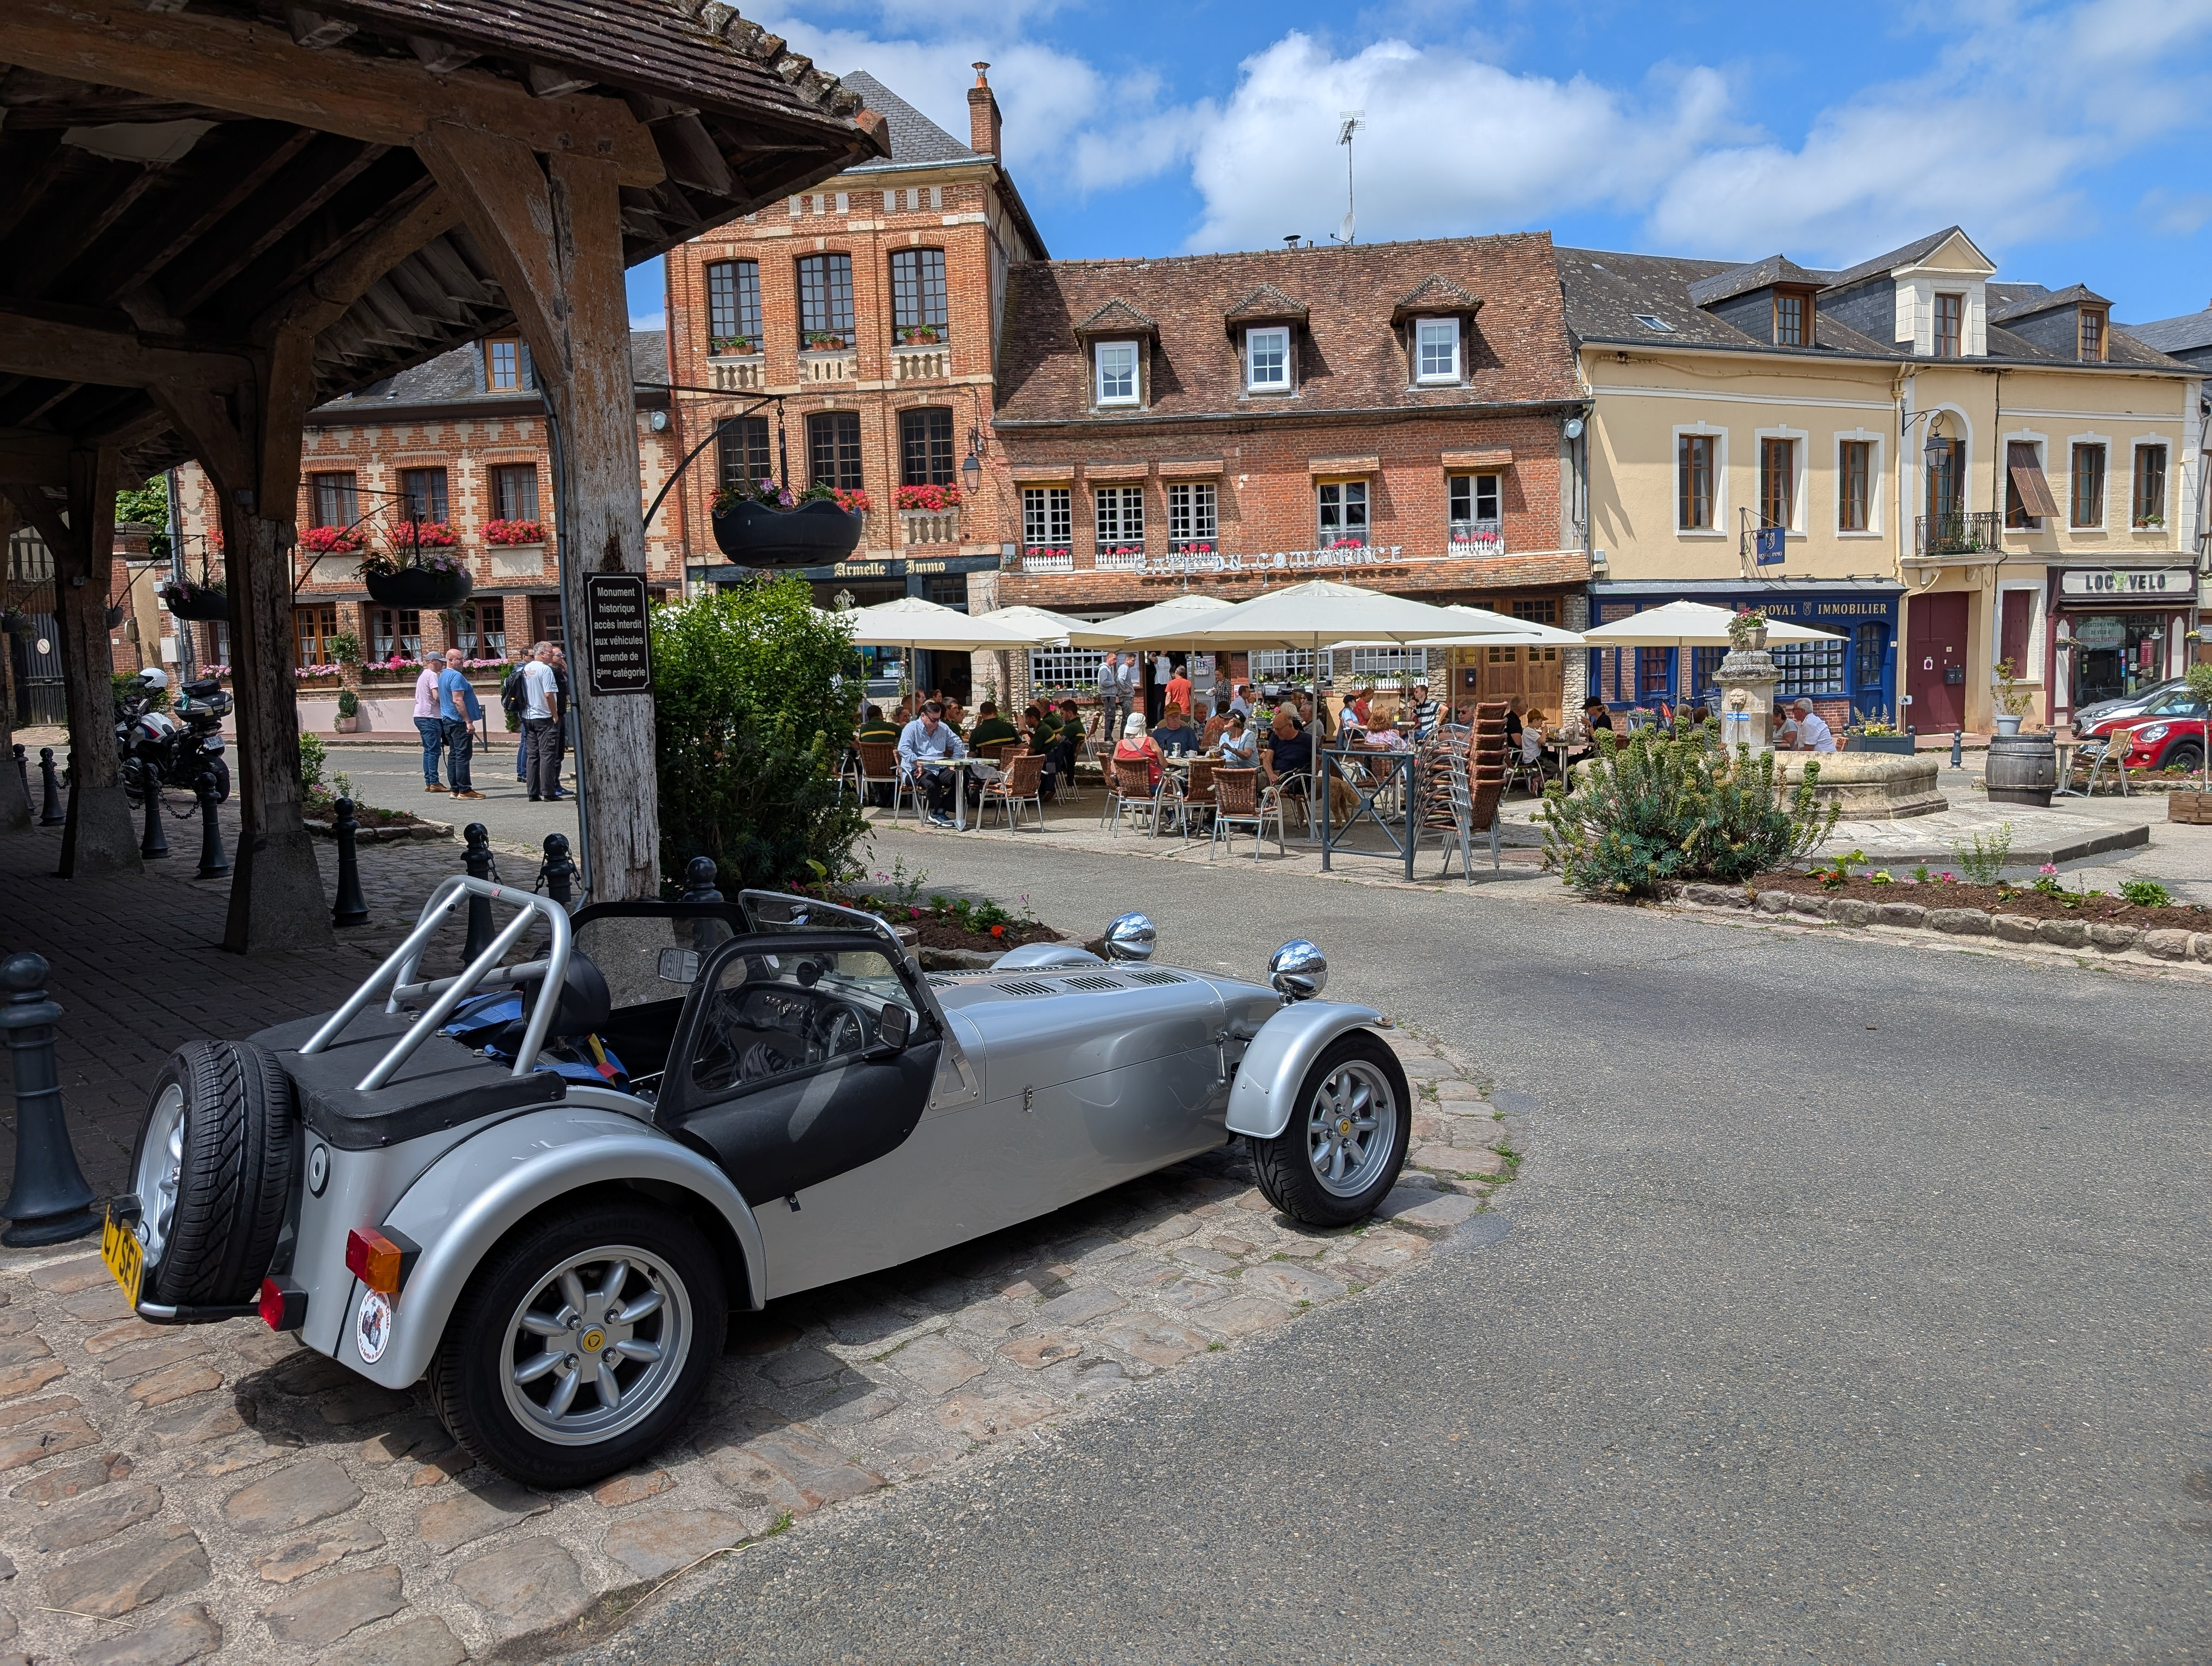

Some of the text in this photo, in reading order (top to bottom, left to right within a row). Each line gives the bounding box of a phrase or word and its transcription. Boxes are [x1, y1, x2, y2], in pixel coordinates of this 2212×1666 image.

[1211, 554, 1243, 572] DU
[1256, 546, 1403, 569] COMMERCE
[834, 560, 946, 577] Armelle Immo
[597, 587, 635, 597] Monument
[599, 604, 635, 614] historique
[1761, 603, 1887, 616] ROYAL IMMOBILIER
[594, 619, 642, 630] accès interdit
[609, 635, 644, 645] véhicules
[600, 651, 639, 662] amende de
[596, 668, 646, 679] 5ème catégorie
[118, 1234, 140, 1297] SEV
[374, 1335, 388, 1359] Summer
